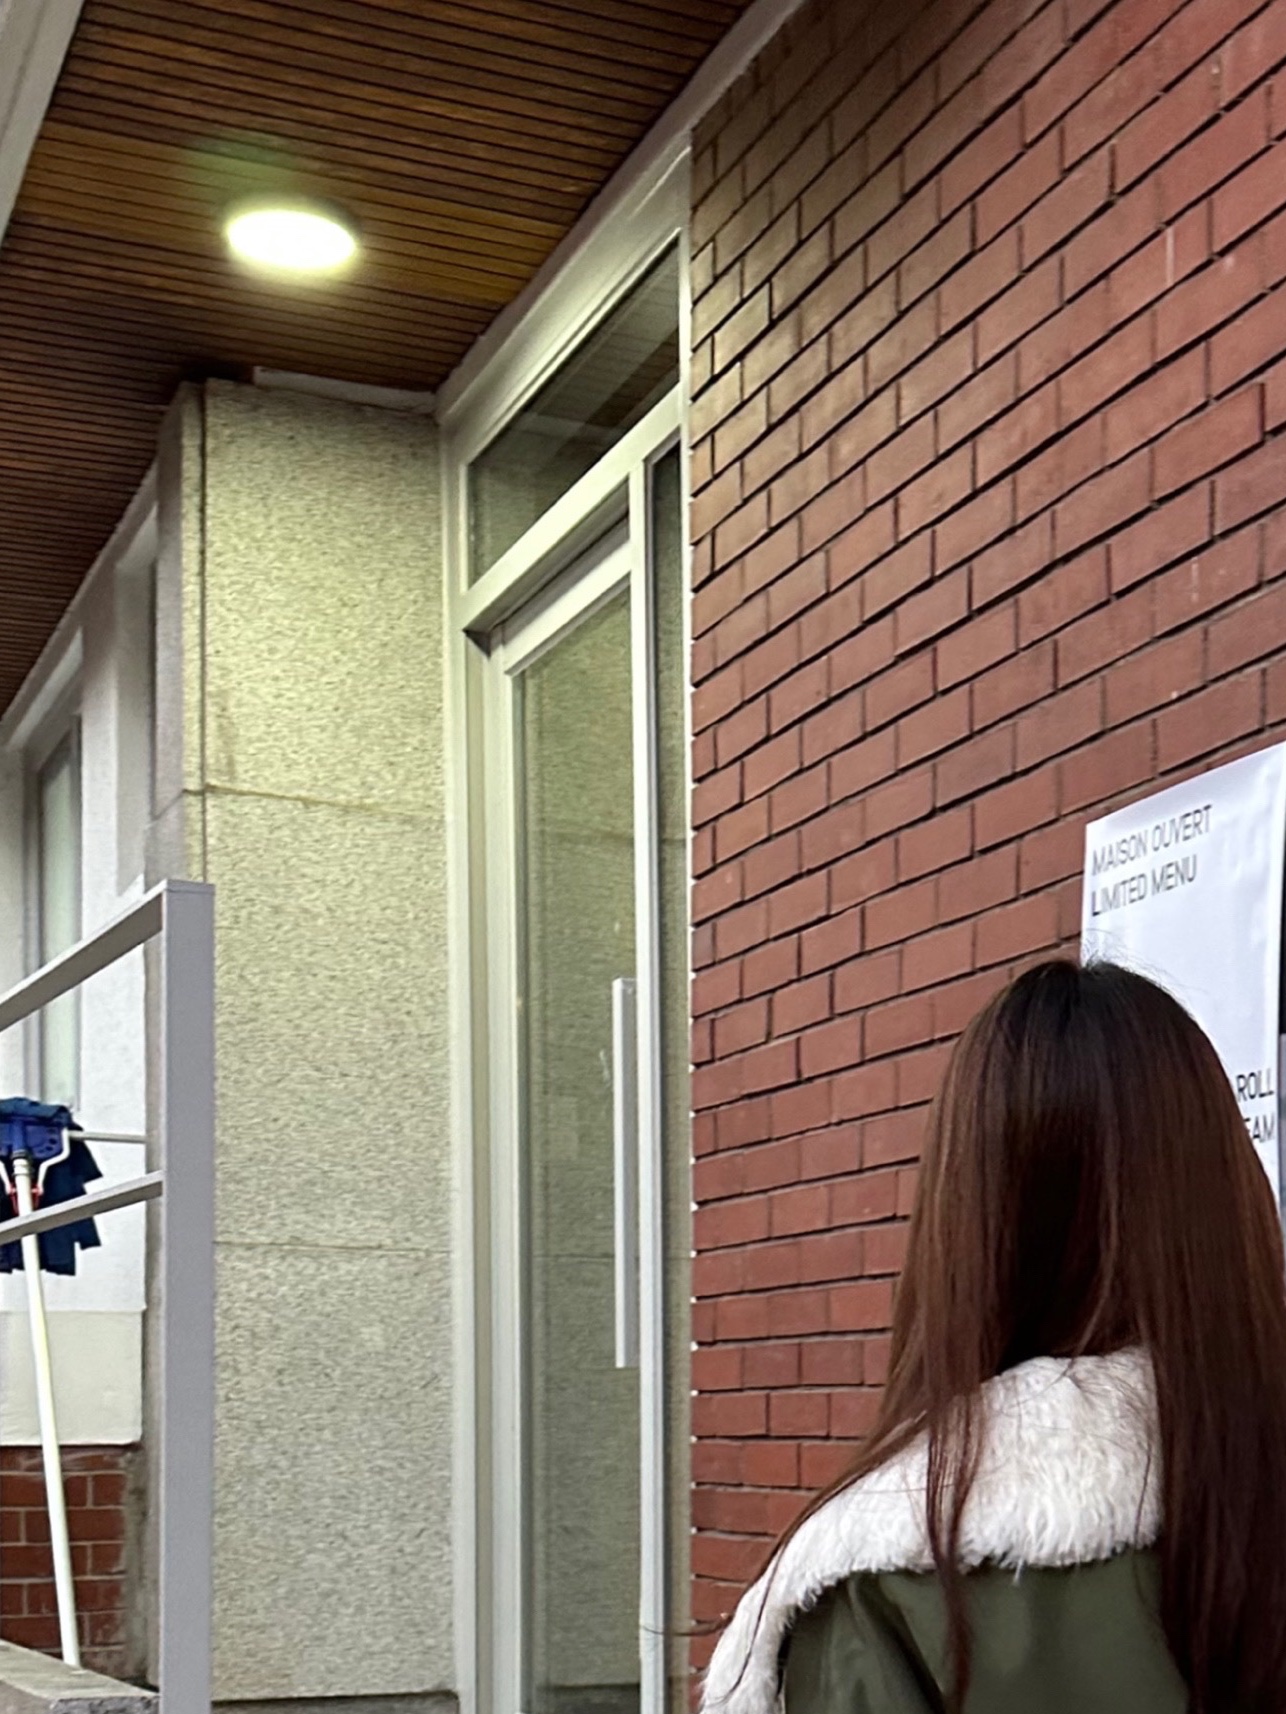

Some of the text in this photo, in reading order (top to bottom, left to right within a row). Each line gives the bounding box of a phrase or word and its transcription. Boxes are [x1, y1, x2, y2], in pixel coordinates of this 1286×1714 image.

[1092, 803, 1212, 876] MAISON OUVERT
[1092, 854, 1198, 917] LIMITED MENU
[1236, 1067, 1275, 1103] ROLL
